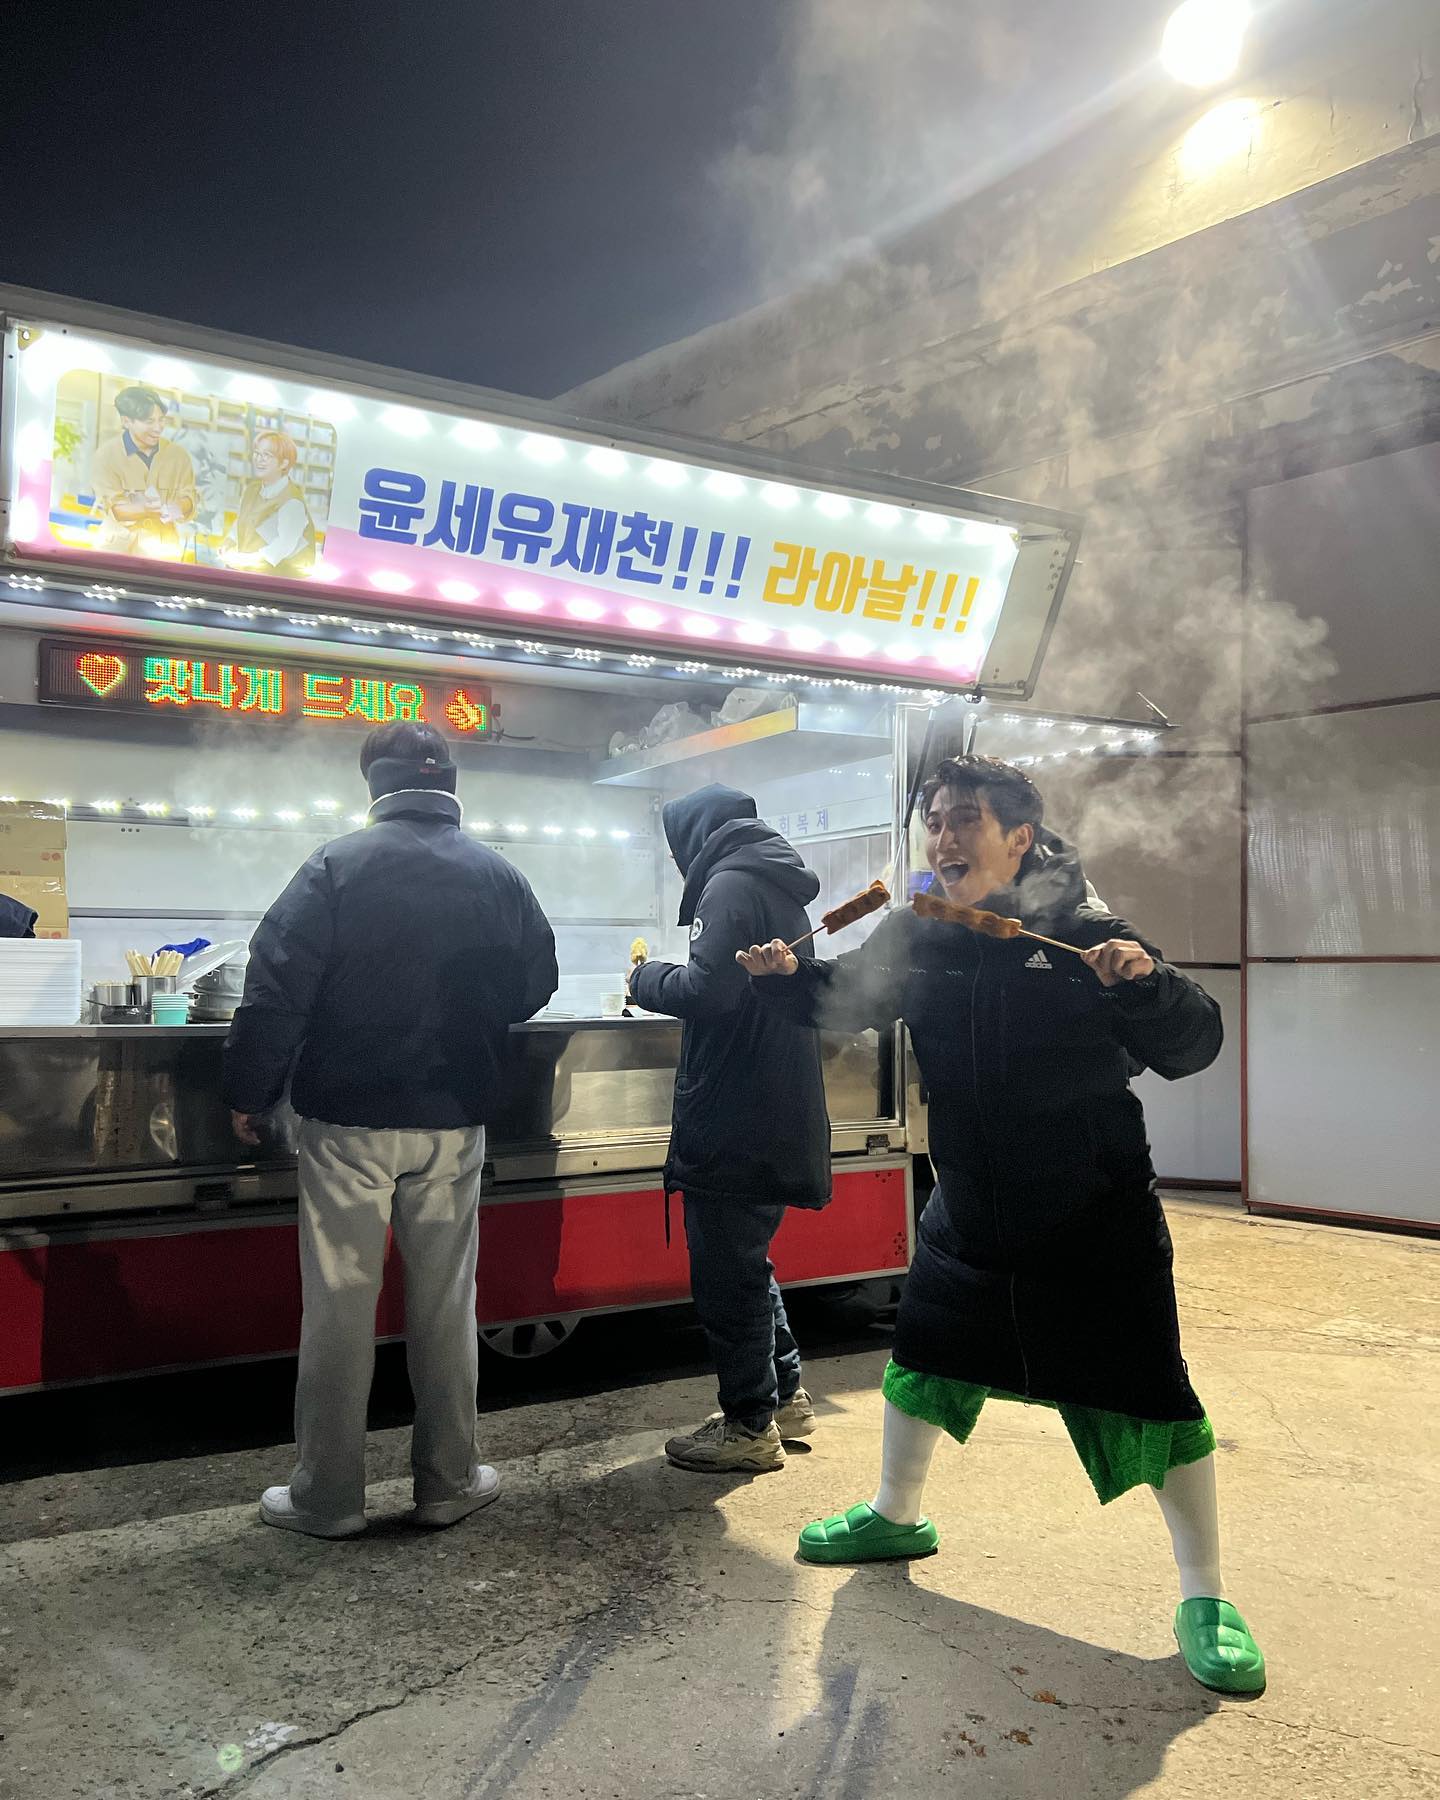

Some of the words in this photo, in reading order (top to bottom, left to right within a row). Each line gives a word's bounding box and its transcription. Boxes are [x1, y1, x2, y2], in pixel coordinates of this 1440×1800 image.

[358, 467, 752, 599] 윤세유재천!!!
[762, 541, 980, 634] 라아날!!!
[144, 656, 283, 714] 맛나게
[302, 672, 426, 723] 드세요
[1024, 961, 1053, 970] adidas
